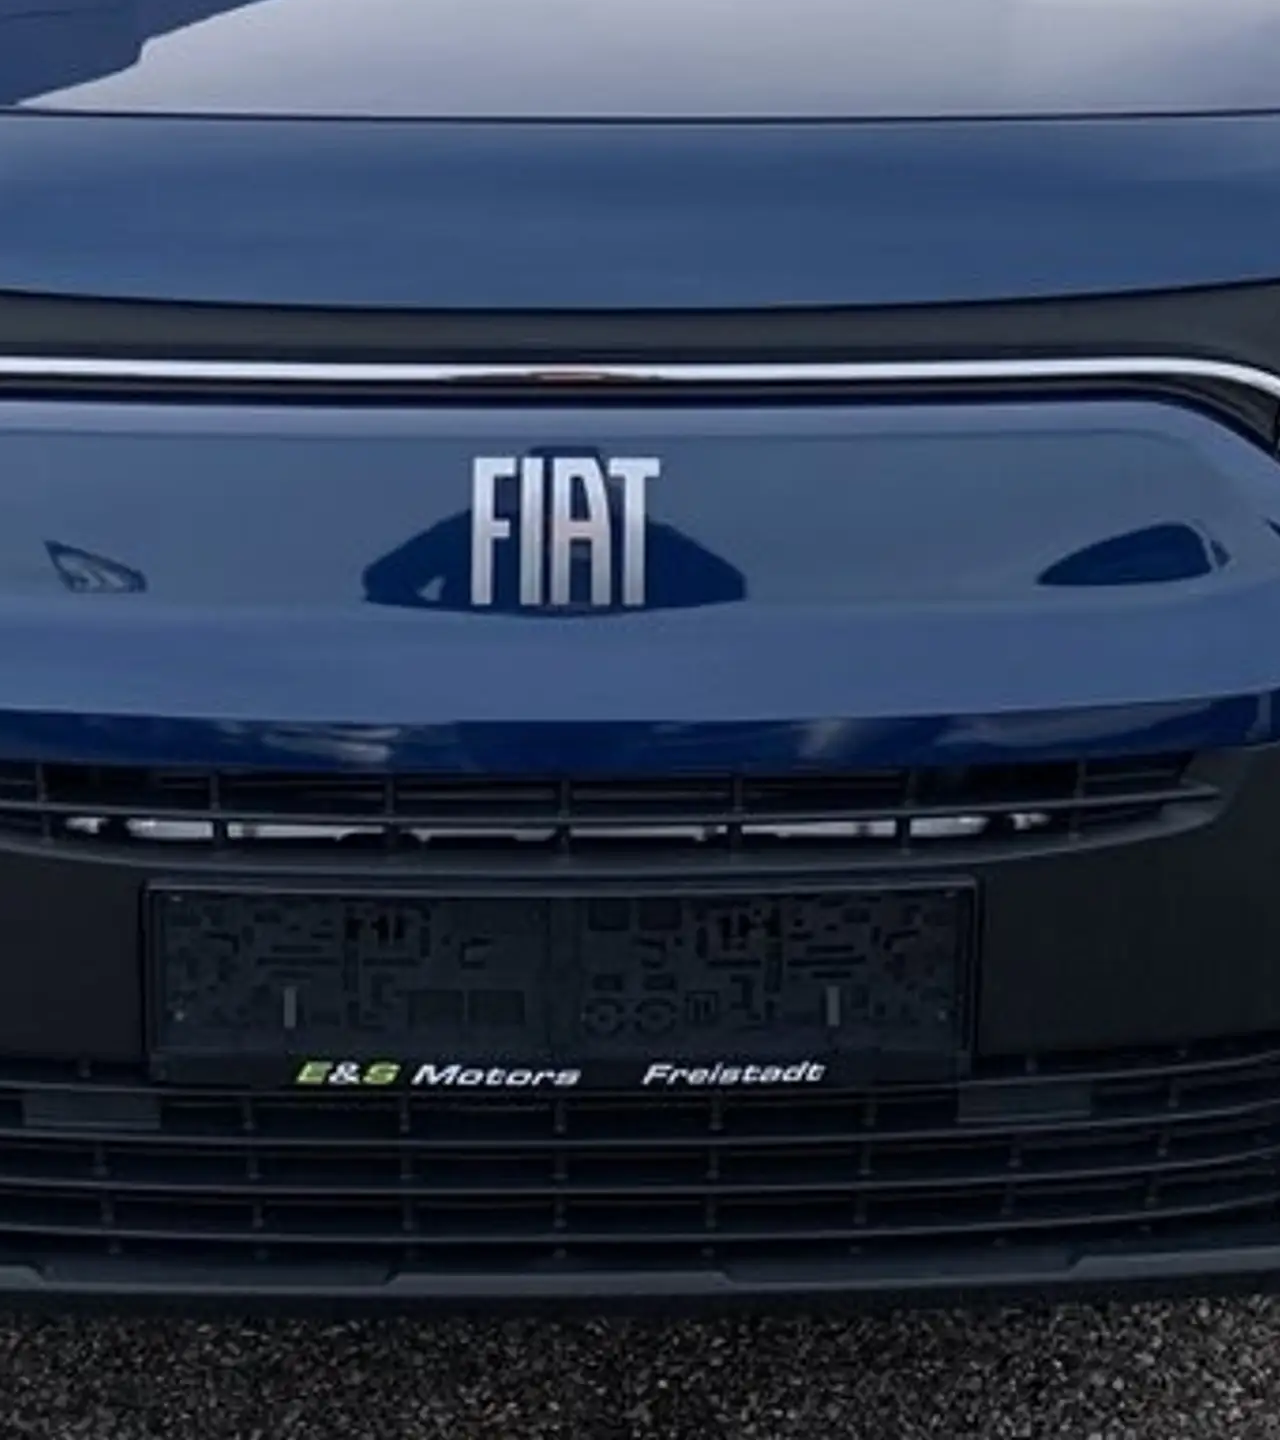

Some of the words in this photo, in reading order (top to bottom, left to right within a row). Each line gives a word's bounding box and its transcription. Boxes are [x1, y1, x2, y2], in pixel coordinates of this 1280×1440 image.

[471, 456, 661, 607] FIAT
[296, 1061, 402, 1086] E&S
[410, 1063, 582, 1086] Motors
[641, 1061, 827, 1086] Freistadt
